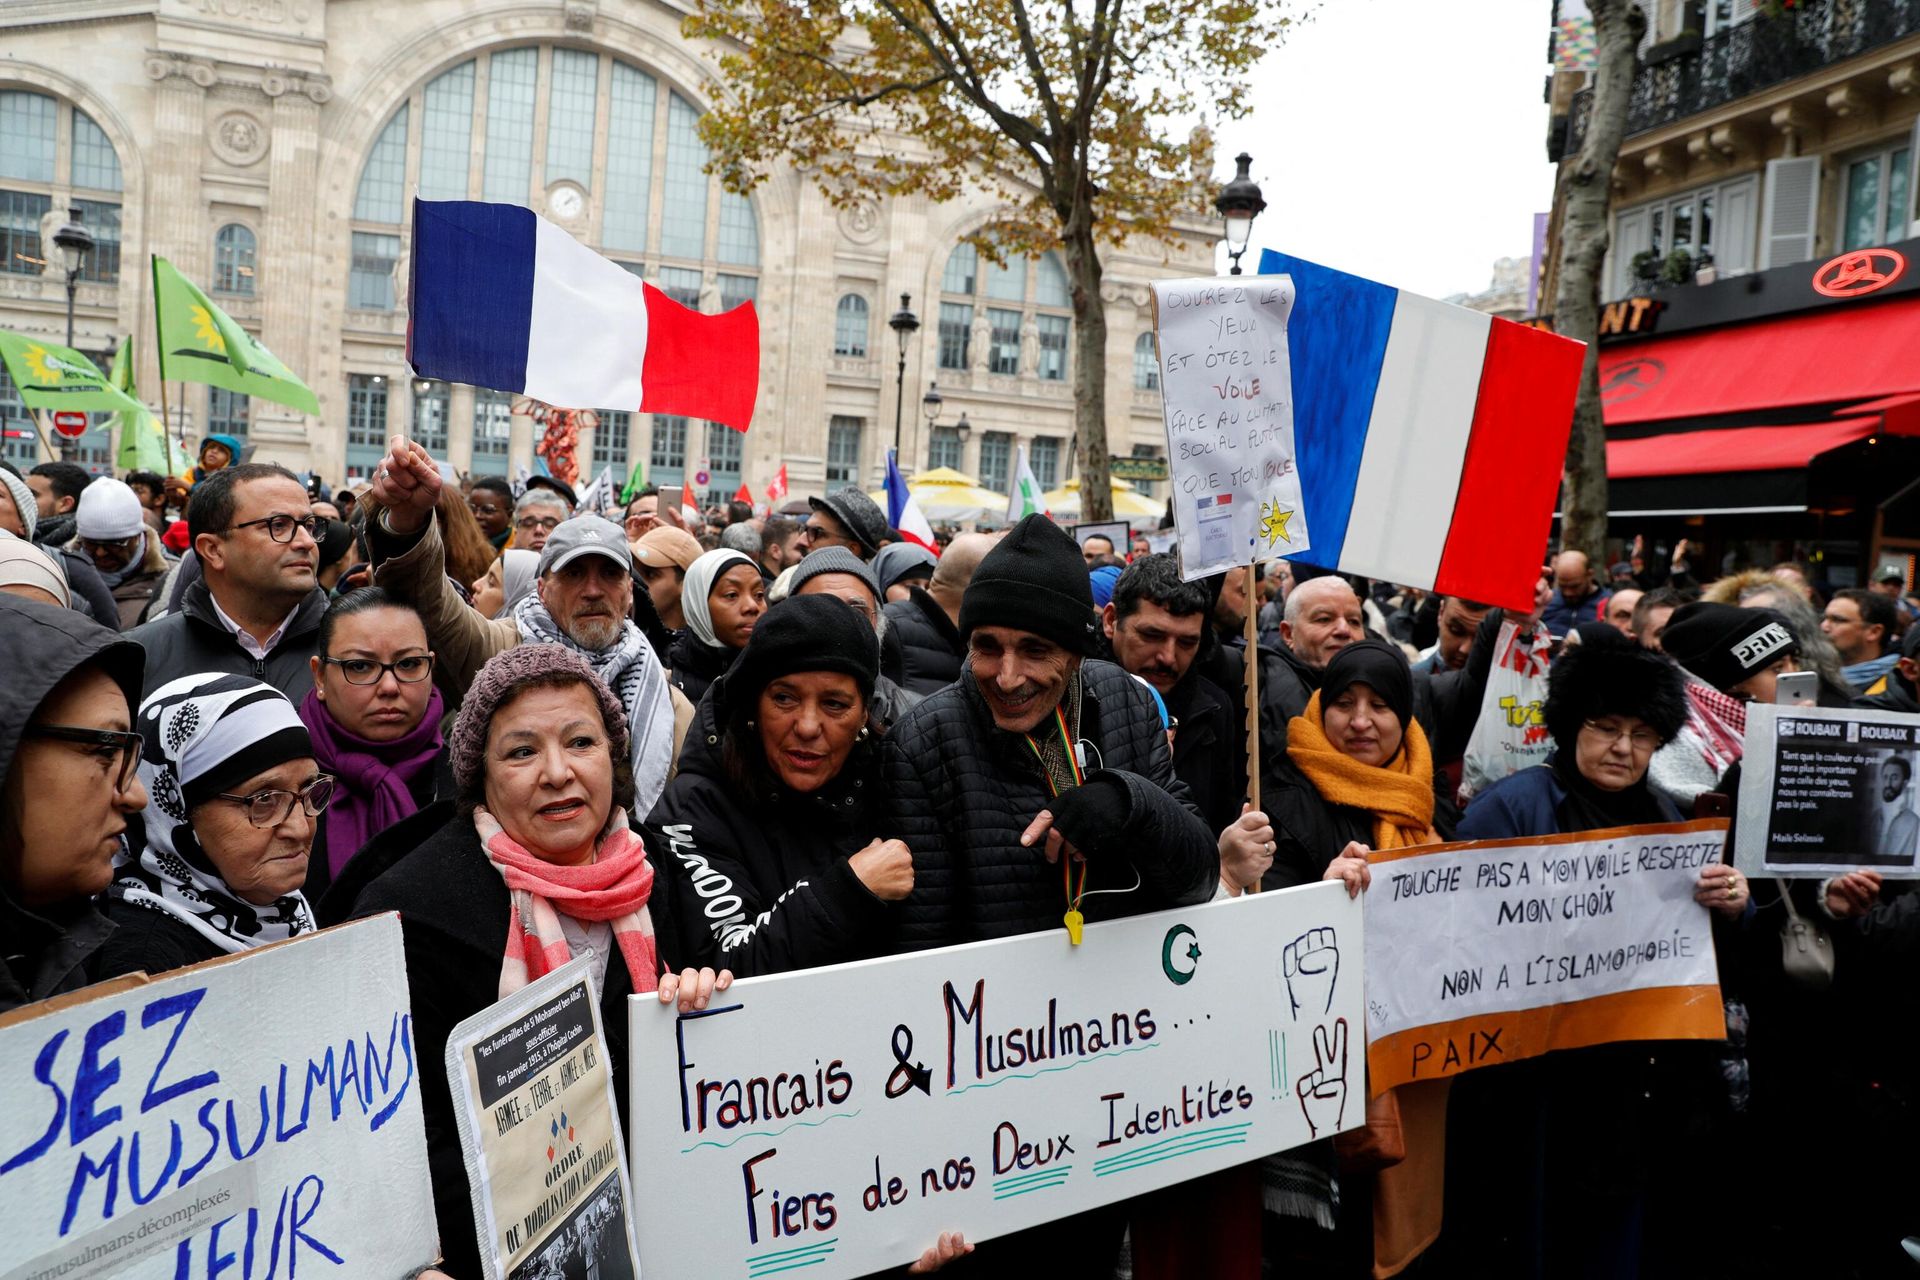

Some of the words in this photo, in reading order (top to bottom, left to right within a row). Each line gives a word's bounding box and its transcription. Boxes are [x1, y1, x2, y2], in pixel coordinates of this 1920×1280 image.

[1167, 286, 1246, 309] OUVREZ
[1260, 288, 1287, 305] LES
[1166, 352, 1195, 374] ET
[1205, 344, 1253, 368] ÔTEZ
[1212, 375, 1261, 400] VOILE
[1171, 410, 1207, 436] FACE
[1217, 411, 1239, 430] AU
[1180, 435, 1237, 461] SOCIAL
[1183, 472, 1221, 500] QUE
[1231, 465, 1259, 488] MON
[1796, 722, 1842, 737] ROUBAIX
[1861, 726, 1908, 741] ROUBAIX
[1799, 763, 1815, 775] plus
[1816, 764, 1858, 776] importante
[1823, 752, 1853, 763] couleur
[1392, 866, 1462, 901] TOUCHE
[1476, 862, 1514, 888] PAS
[1516, 861, 1530, 886] A
[1542, 857, 1580, 886] MON
[1584, 844, 1631, 881] VOILE
[1497, 899, 1554, 926] MON
[1562, 883, 1616, 920] CHOIX
[1441, 967, 1483, 1000] NON
[1495, 964, 1510, 991] A
[492, 1026, 524, 1052] funérailles
[523, 1021, 532, 1034] de
[530, 1018, 536, 1029] Si
[535, 1001, 562, 1024] Mohamed
[560, 995, 571, 1009] ben
[525, 1023, 558, 1050] sous-officier
[496, 1074, 507, 1087] fin
[506, 1061, 529, 1083] janvier
[542, 1045, 549, 1057] à
[567, 1024, 583, 1041] Cochin
[676, 1004, 853, 1133] Francais
[885, 1024, 933, 1099] &
[943, 978, 1157, 1090] Musulmans
[1411, 1027, 1505, 1078] PAIX
[530, 1075, 555, 1112] TERRE
[582, 1043, 598, 1072] MER
[60, 1011, 414, 1238] MUSULMANS
[545, 1142, 585, 1189] ORDRE
[742, 1148, 837, 1245] Fiers
[863, 1155, 908, 1212] de
[921, 1156, 976, 1198] nos
[993, 1121, 1076, 1177] Deux
[1096, 1078, 1254, 1149] Identités
[137, 1187, 231, 1239] décomplexés
[505, 1223, 522, 1255] DE
[524, 1171, 581, 1240] MOBILISATION
